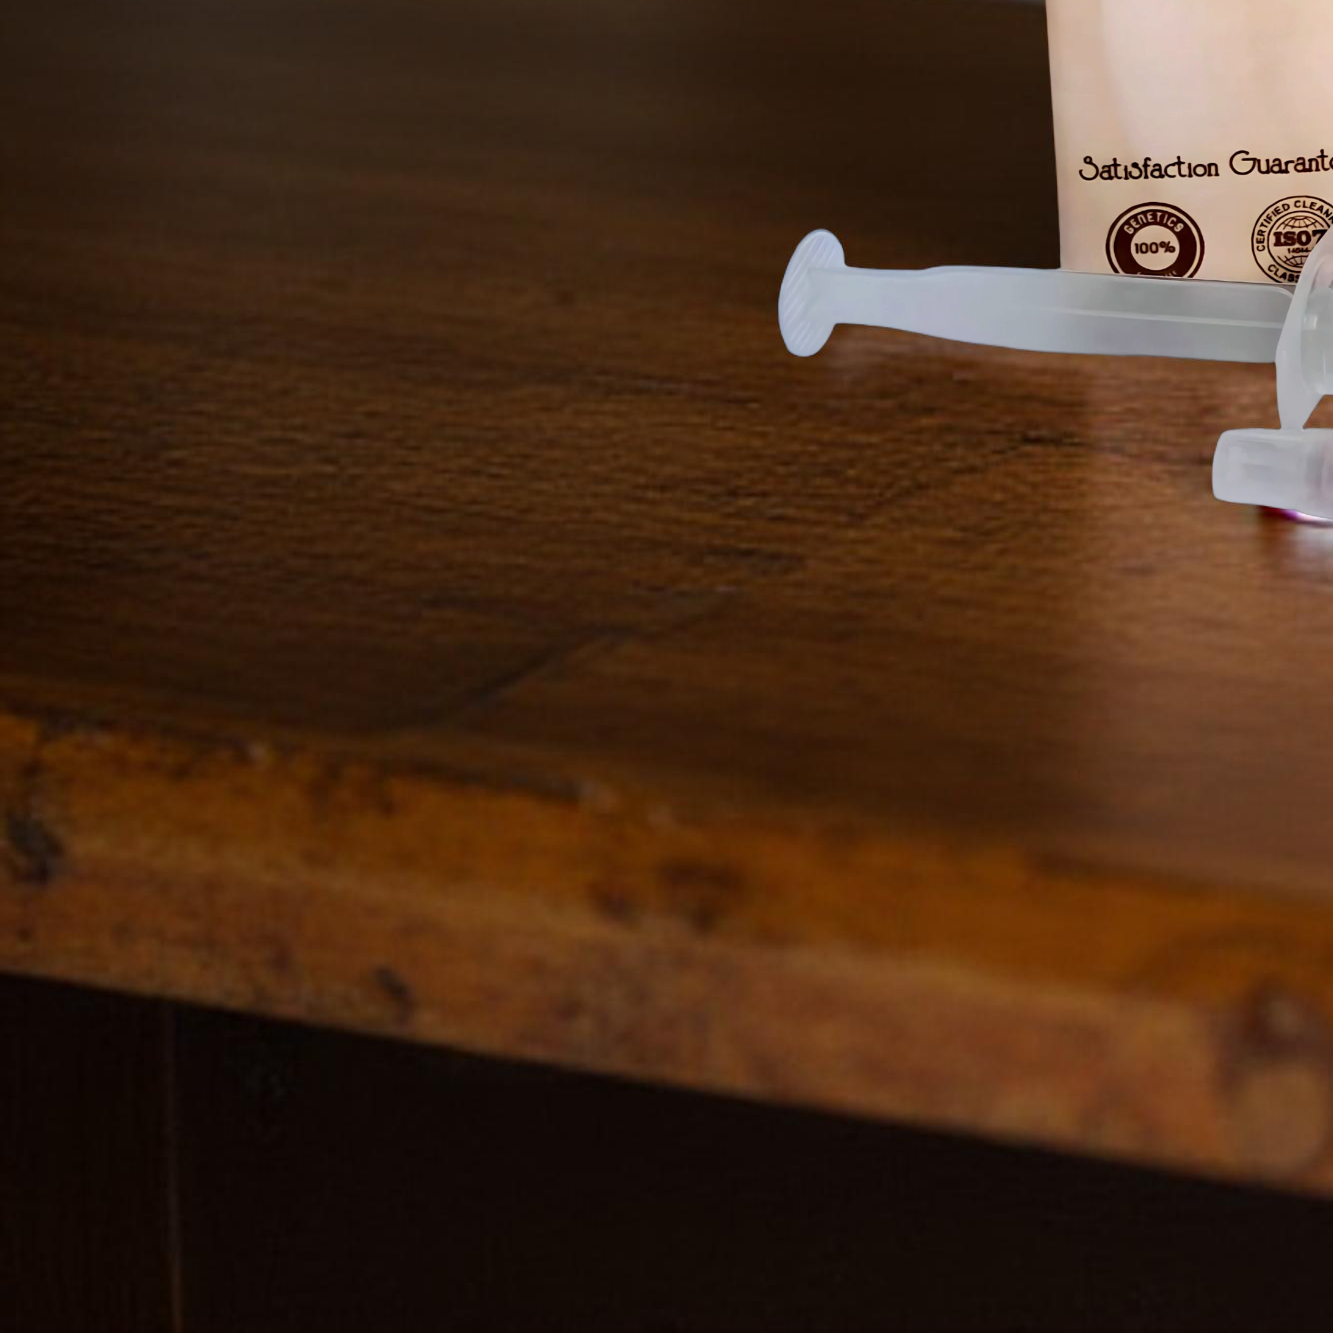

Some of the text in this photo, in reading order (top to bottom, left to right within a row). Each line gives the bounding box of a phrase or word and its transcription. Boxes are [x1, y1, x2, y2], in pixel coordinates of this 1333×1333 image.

[1078, 155, 1221, 182] Satisfaction
[1124, 212, 1184, 234] GENETICS
[1256, 203, 1290, 251] CERTIFIED
[1134, 241, 1176, 254] 100%
